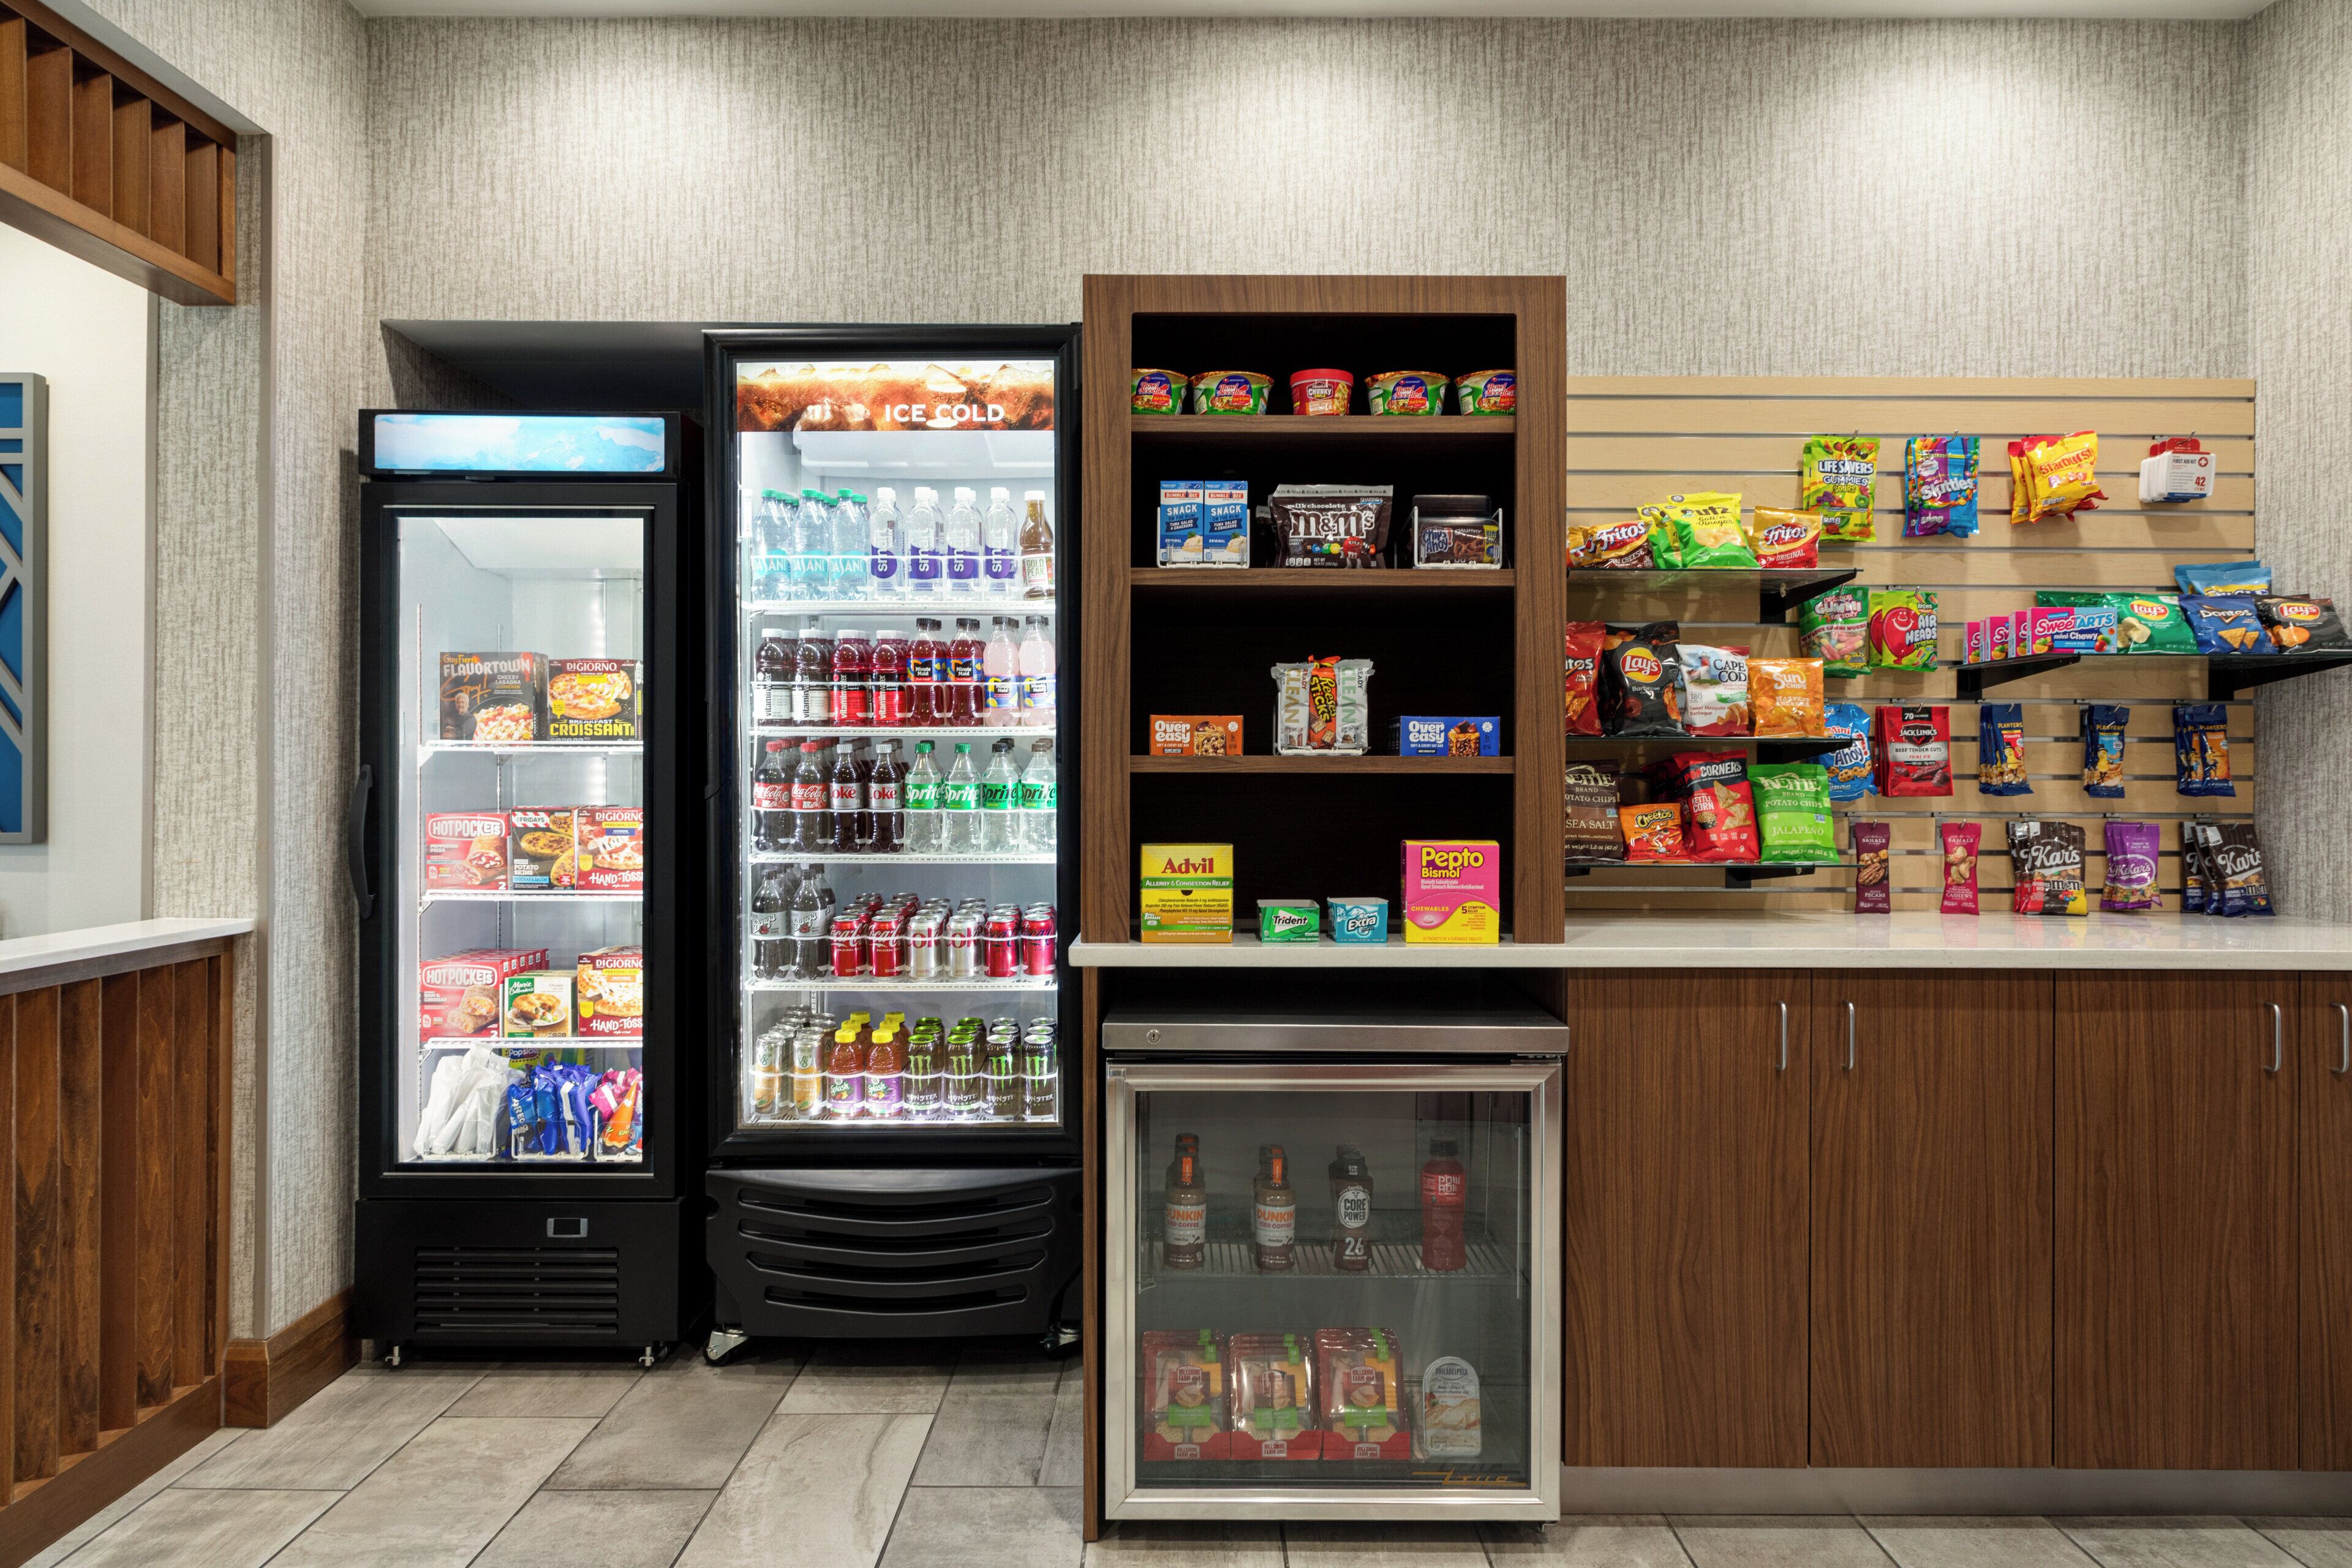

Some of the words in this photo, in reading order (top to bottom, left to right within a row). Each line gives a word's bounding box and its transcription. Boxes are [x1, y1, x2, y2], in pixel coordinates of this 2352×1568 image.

[1141, 381, 1159, 390] Bowl
[1219, 382, 1239, 391] Bowl
[1396, 384, 1415, 393] Bowl
[1487, 383, 1507, 391] Bowl
[885, 404, 927, 422] ICE
[934, 403, 1005, 423] COLD
[2038, 447, 2094, 475] Starburst
[1823, 475, 1869, 486] GUMMIES
[2195, 476, 2206, 487] 42
[1833, 484, 1856, 494] SOURS
[1920, 477, 1974, 501] Skittles
[1167, 503, 1197, 516] SNACK
[1210, 504, 1242, 516] SNACK
[1595, 521, 1646, 551] Fritos
[1763, 524, 1807, 545] Fritos
[1026, 559, 1044, 568] GOLD
[1027, 567, 1046, 576] PEAK
[1814, 601, 1863, 615] GUMMI
[2133, 604, 2166, 617] Lay's
[2200, 609, 2253, 619] Doritos
[1830, 611, 1859, 620] FACTORY
[1918, 614, 1937, 628] AIR
[1905, 627, 1937, 645] HEADS
[2070, 631, 2098, 641] Chewy
[443, 658, 530, 677] FLAVORTOWN
[1624, 655, 1659, 676] Lay's
[1713, 658, 1746, 671] CAPE
[1718, 670, 1747, 683] COD
[1773, 671, 1806, 690] Sun
[1284, 667, 1301, 723] CLEAN
[1341, 666, 1357, 723] CLEAN
[549, 723, 631, 736] CROISSANT
[1155, 720, 1191, 733] Over
[1409, 720, 1445, 734] Over
[1155, 731, 1191, 744] easy
[1409, 731, 1445, 744] easy
[1684, 761, 1742, 785] POPCORNERS
[1756, 772, 1822, 793] KETTLE
[792, 783, 825, 798] Coca-Cola
[905, 784, 941, 803] Sprite
[944, 784, 980, 804] Sprite
[982, 785, 1017, 804] Sprite
[1021, 784, 1056, 804] Sprite
[1691, 796, 1713, 805] KETTLE
[1692, 801, 1714, 813] CORN
[1566, 819, 1586, 829] SEA
[1589, 821, 1615, 830] SALT
[1636, 810, 1674, 829] Cheetos
[1772, 825, 1824, 836] JALAPEÑO
[1421, 846, 1484, 870] Pepto
[2030, 845, 2081, 867] Kar's
[1161, 857, 1214, 875] Advil
[1421, 867, 1460, 878] Bismol
[498, 881, 507, 890] 2
[1461, 906, 1468, 914] 5
[753, 913, 777, 933] Barq's
[793, 911, 818, 932] Barq's
[1273, 915, 1308, 925] Trident
[1348, 916, 1376, 930] Extra
[510, 981, 532, 990] Marie
[509, 1048, 539, 1058] Popsicle
[798, 1055, 812, 1068] V8
[831, 1082, 850, 1095] Splash
[868, 1082, 886, 1095] Splash
[907, 1093, 938, 1102] MONSTER
[1344, 1198, 1366, 1211] CORE
[1344, 1210, 1366, 1221] POWER
[1344, 1237, 1365, 1256] 26
[1435, 1368, 1468, 1376] PHILADELPHIA
